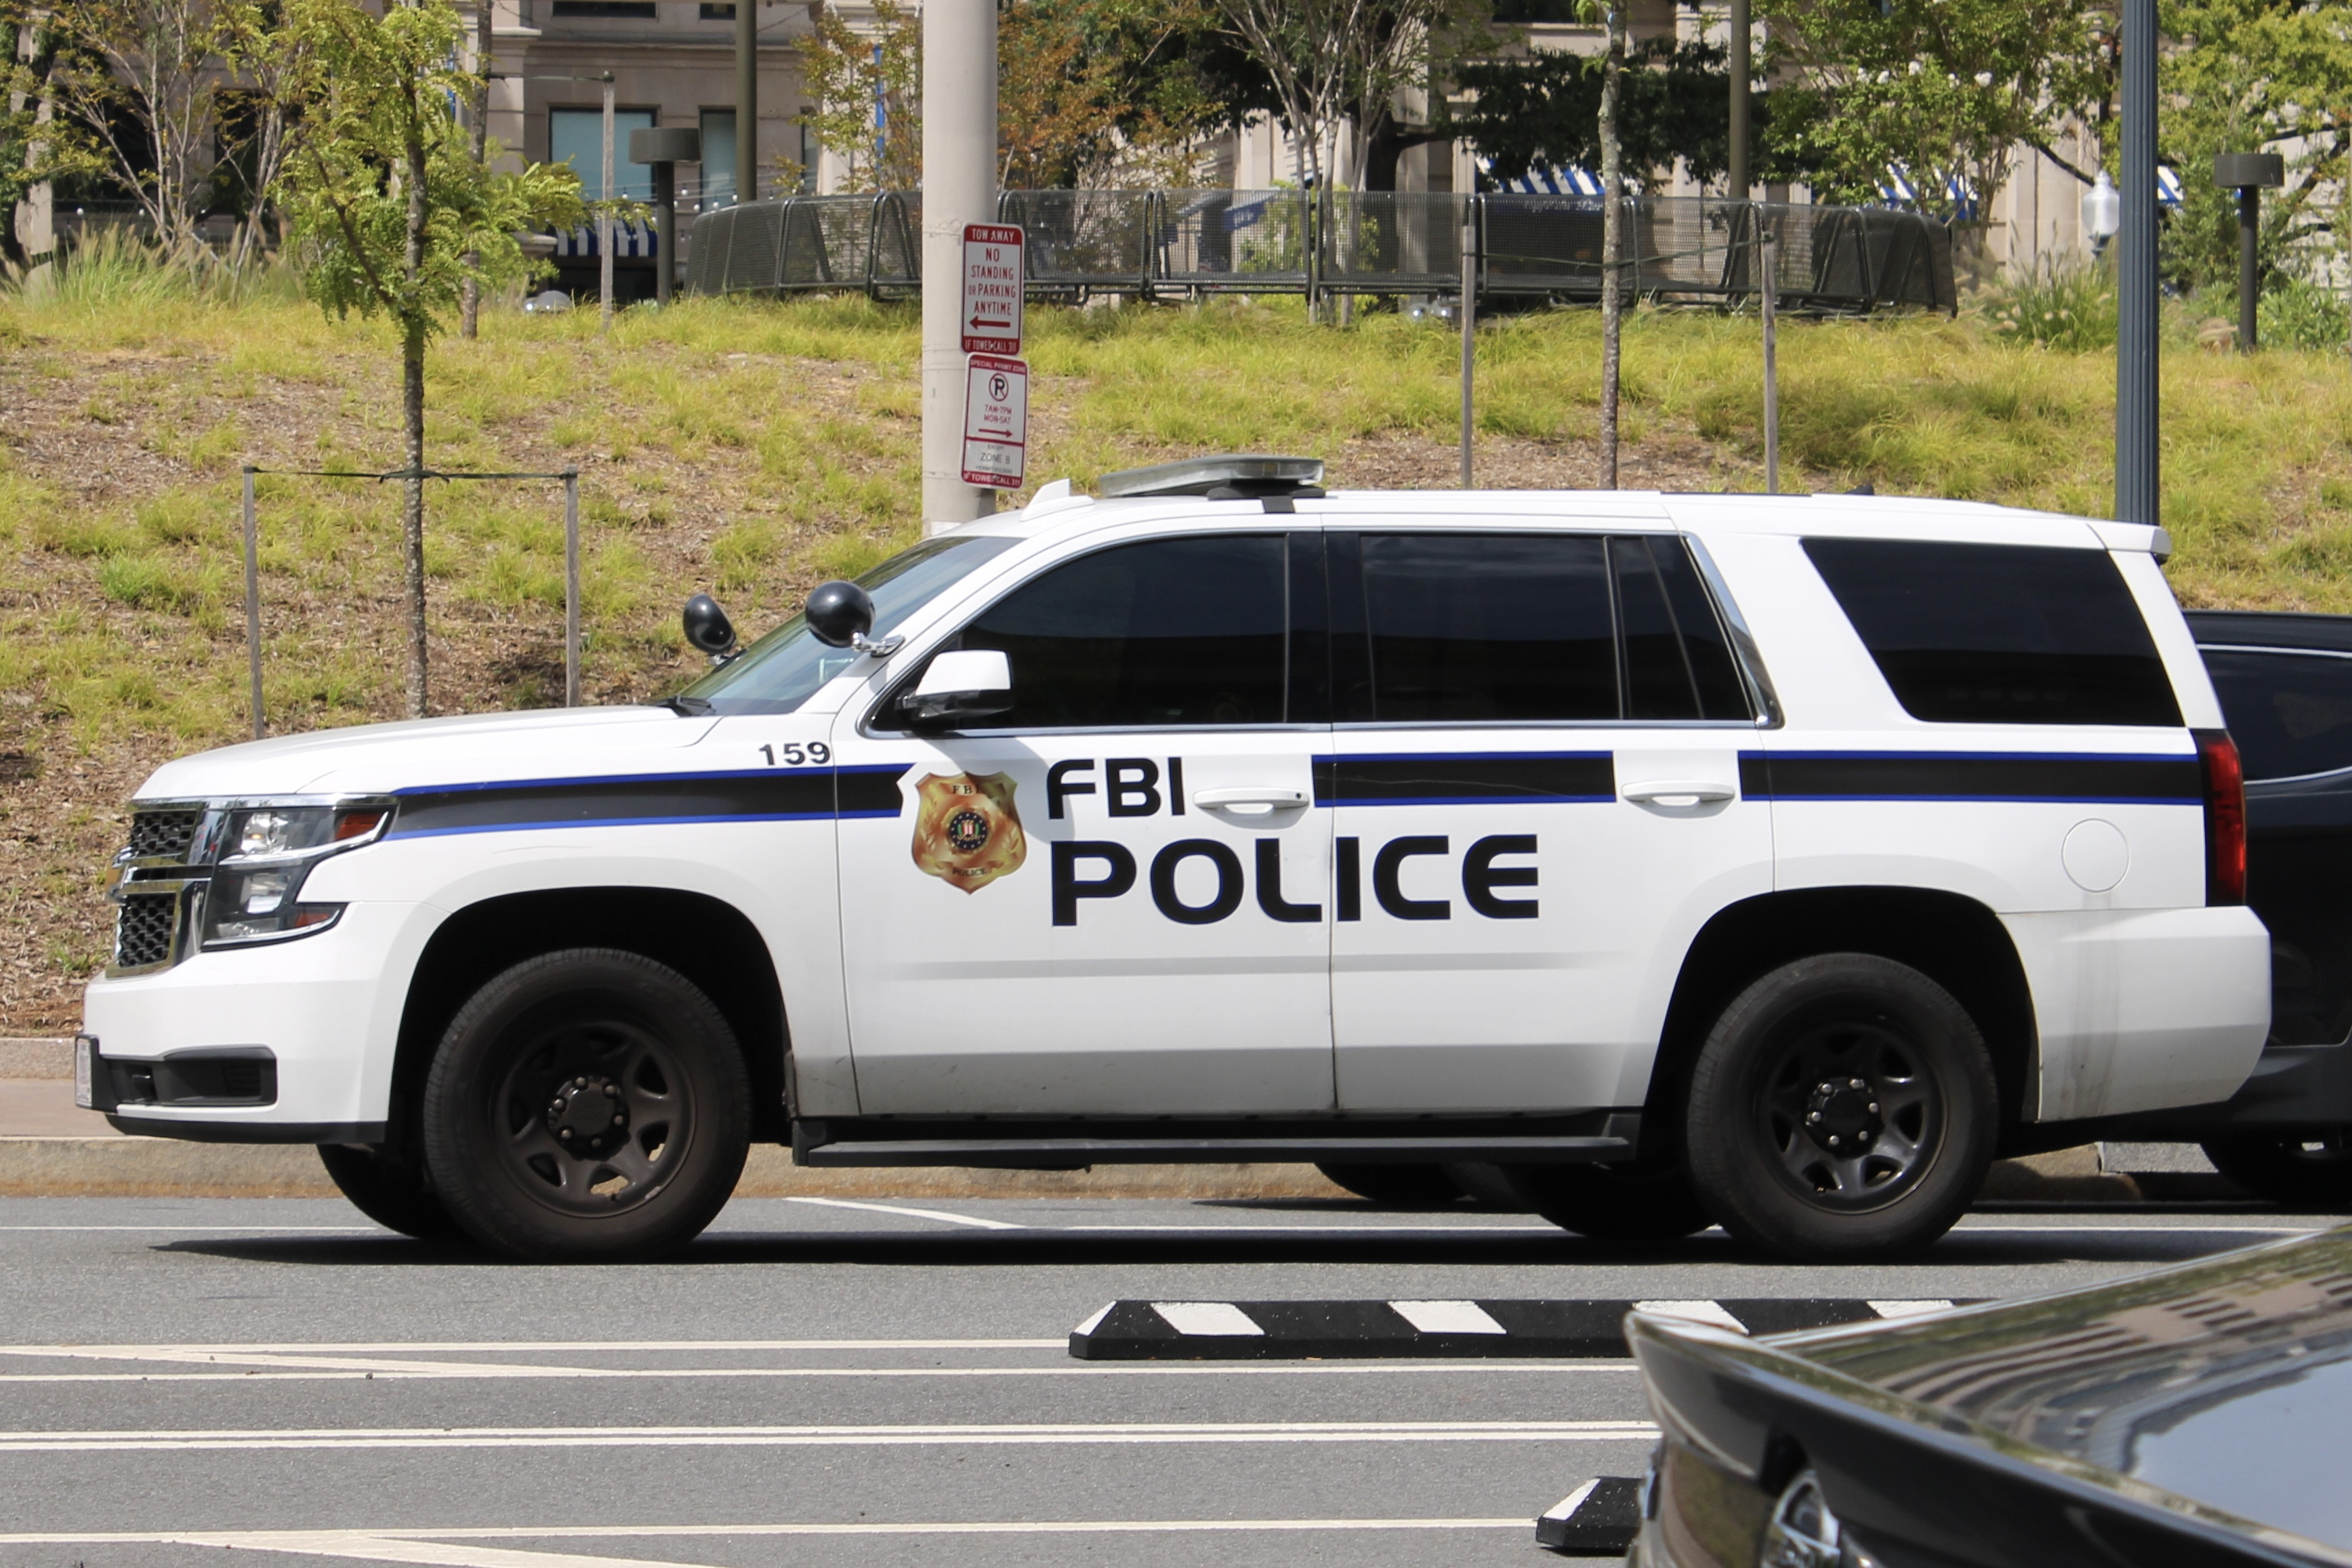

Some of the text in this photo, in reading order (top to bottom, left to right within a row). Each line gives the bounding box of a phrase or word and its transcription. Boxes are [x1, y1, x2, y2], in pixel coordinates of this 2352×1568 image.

[972, 228, 1014, 242] TOW AWAY
[986, 247, 999, 262] NO
[971, 265, 1014, 280] STANDING
[968, 283, 1016, 297] OR PARKING
[974, 301, 1011, 315] ANYTIME
[965, 339, 971, 350] IF
[985, 405, 1012, 414] 7AM-7PM
[983, 414, 1010, 424] MON-SAT
[981, 452, 1002, 463] ZONE
[759, 741, 830, 766] 159
[1047, 757, 1186, 819] FBI
[952, 867, 987, 875] POLICE
[1051, 834, 1539, 926] POLICE
